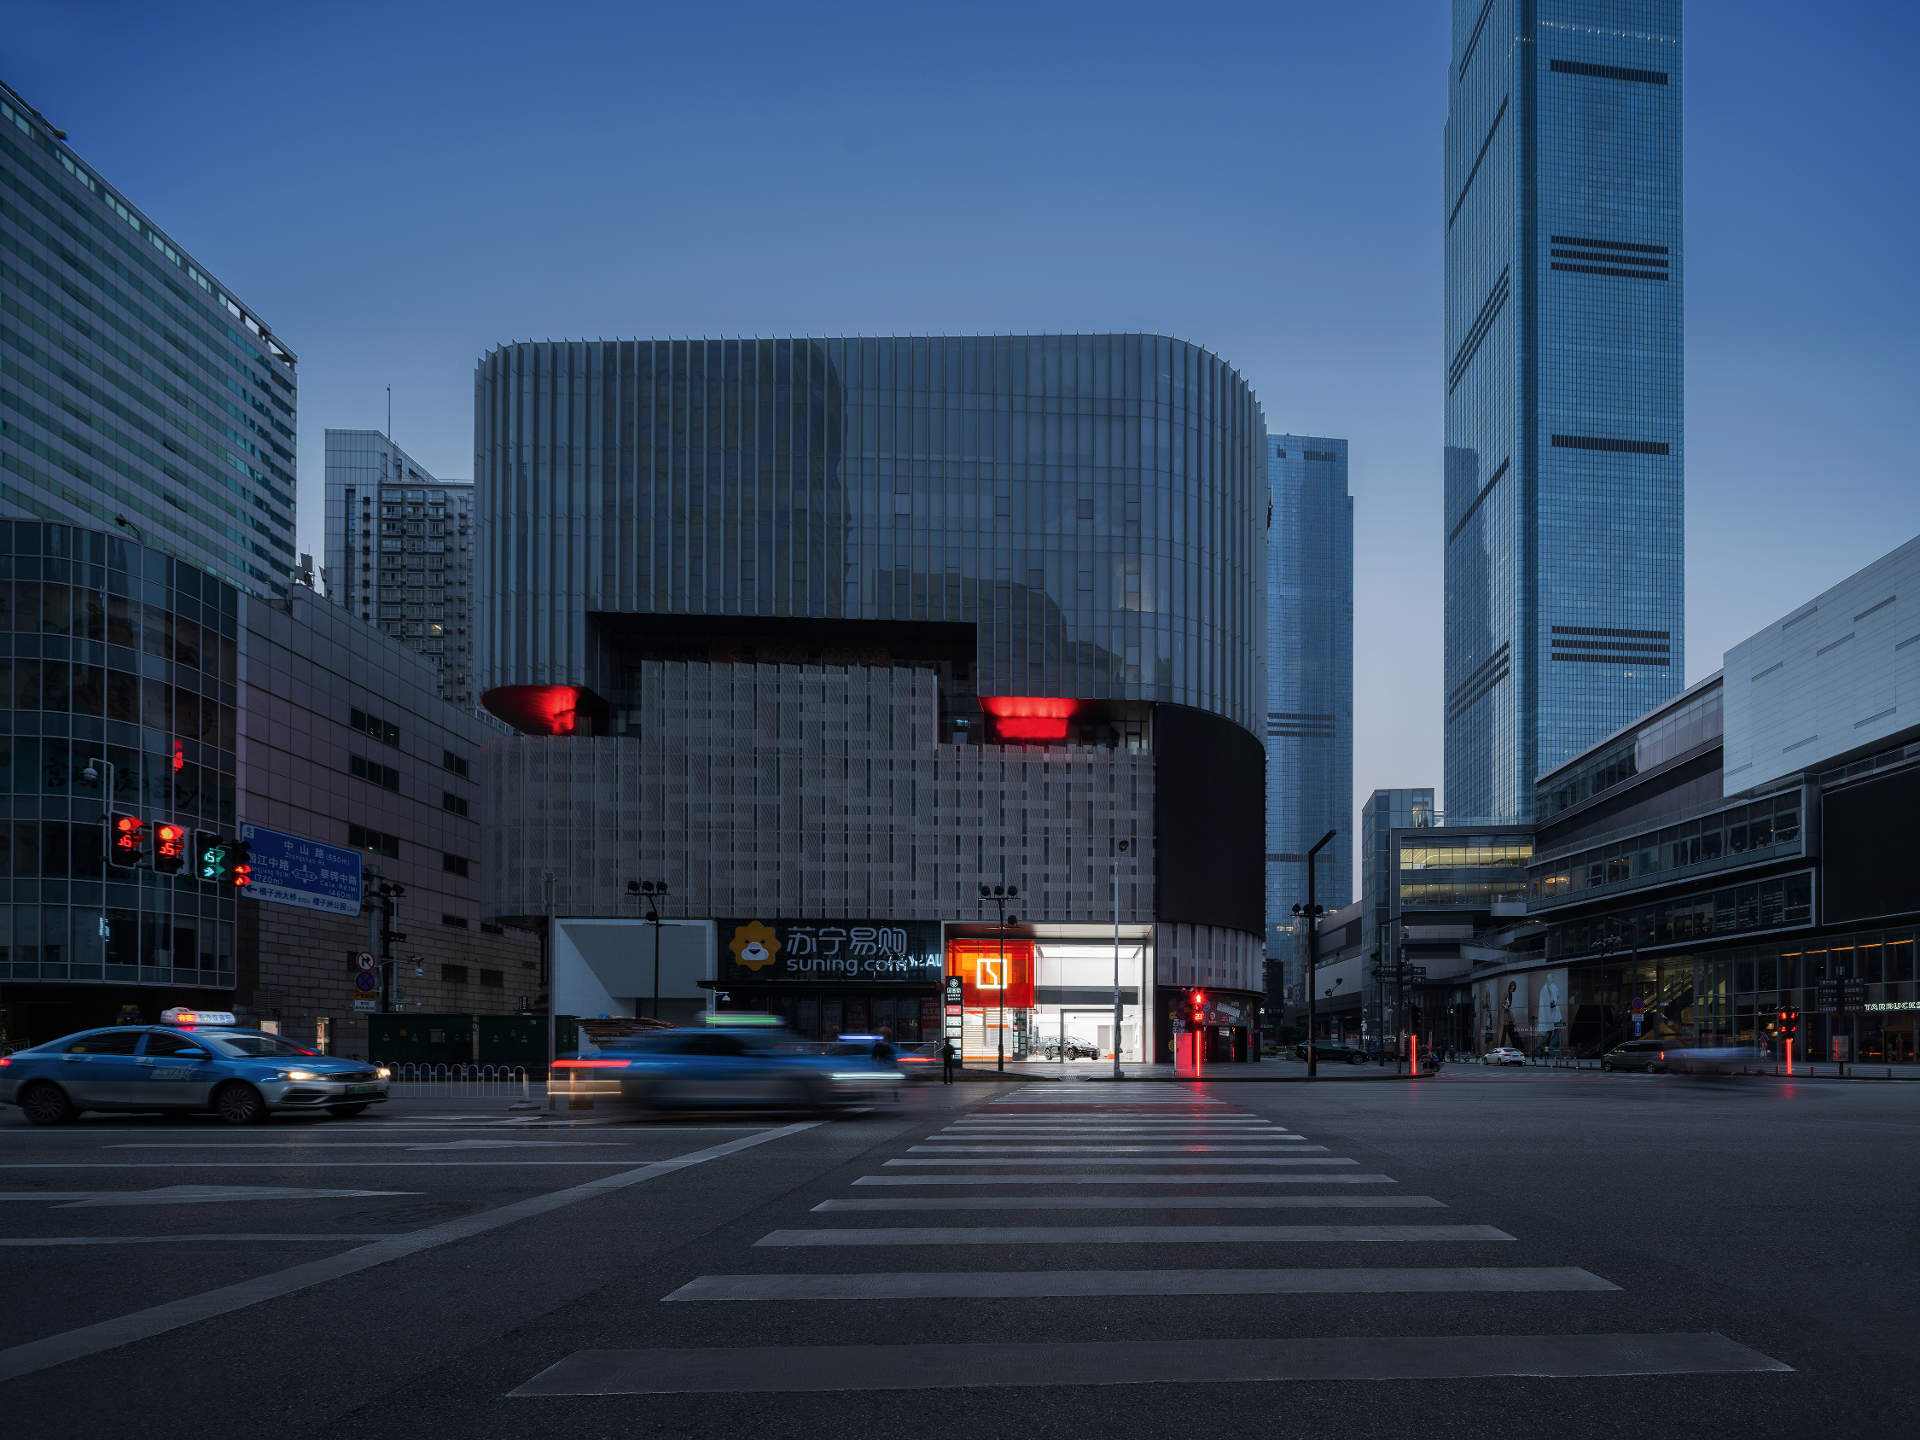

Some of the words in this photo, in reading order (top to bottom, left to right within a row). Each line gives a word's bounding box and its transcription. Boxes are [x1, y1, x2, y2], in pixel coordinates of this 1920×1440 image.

[786, 926, 909, 956] 苏宁易购
[786, 959, 908, 977] suning.com
[1864, 1001, 1920, 1012] TARBUCKS
